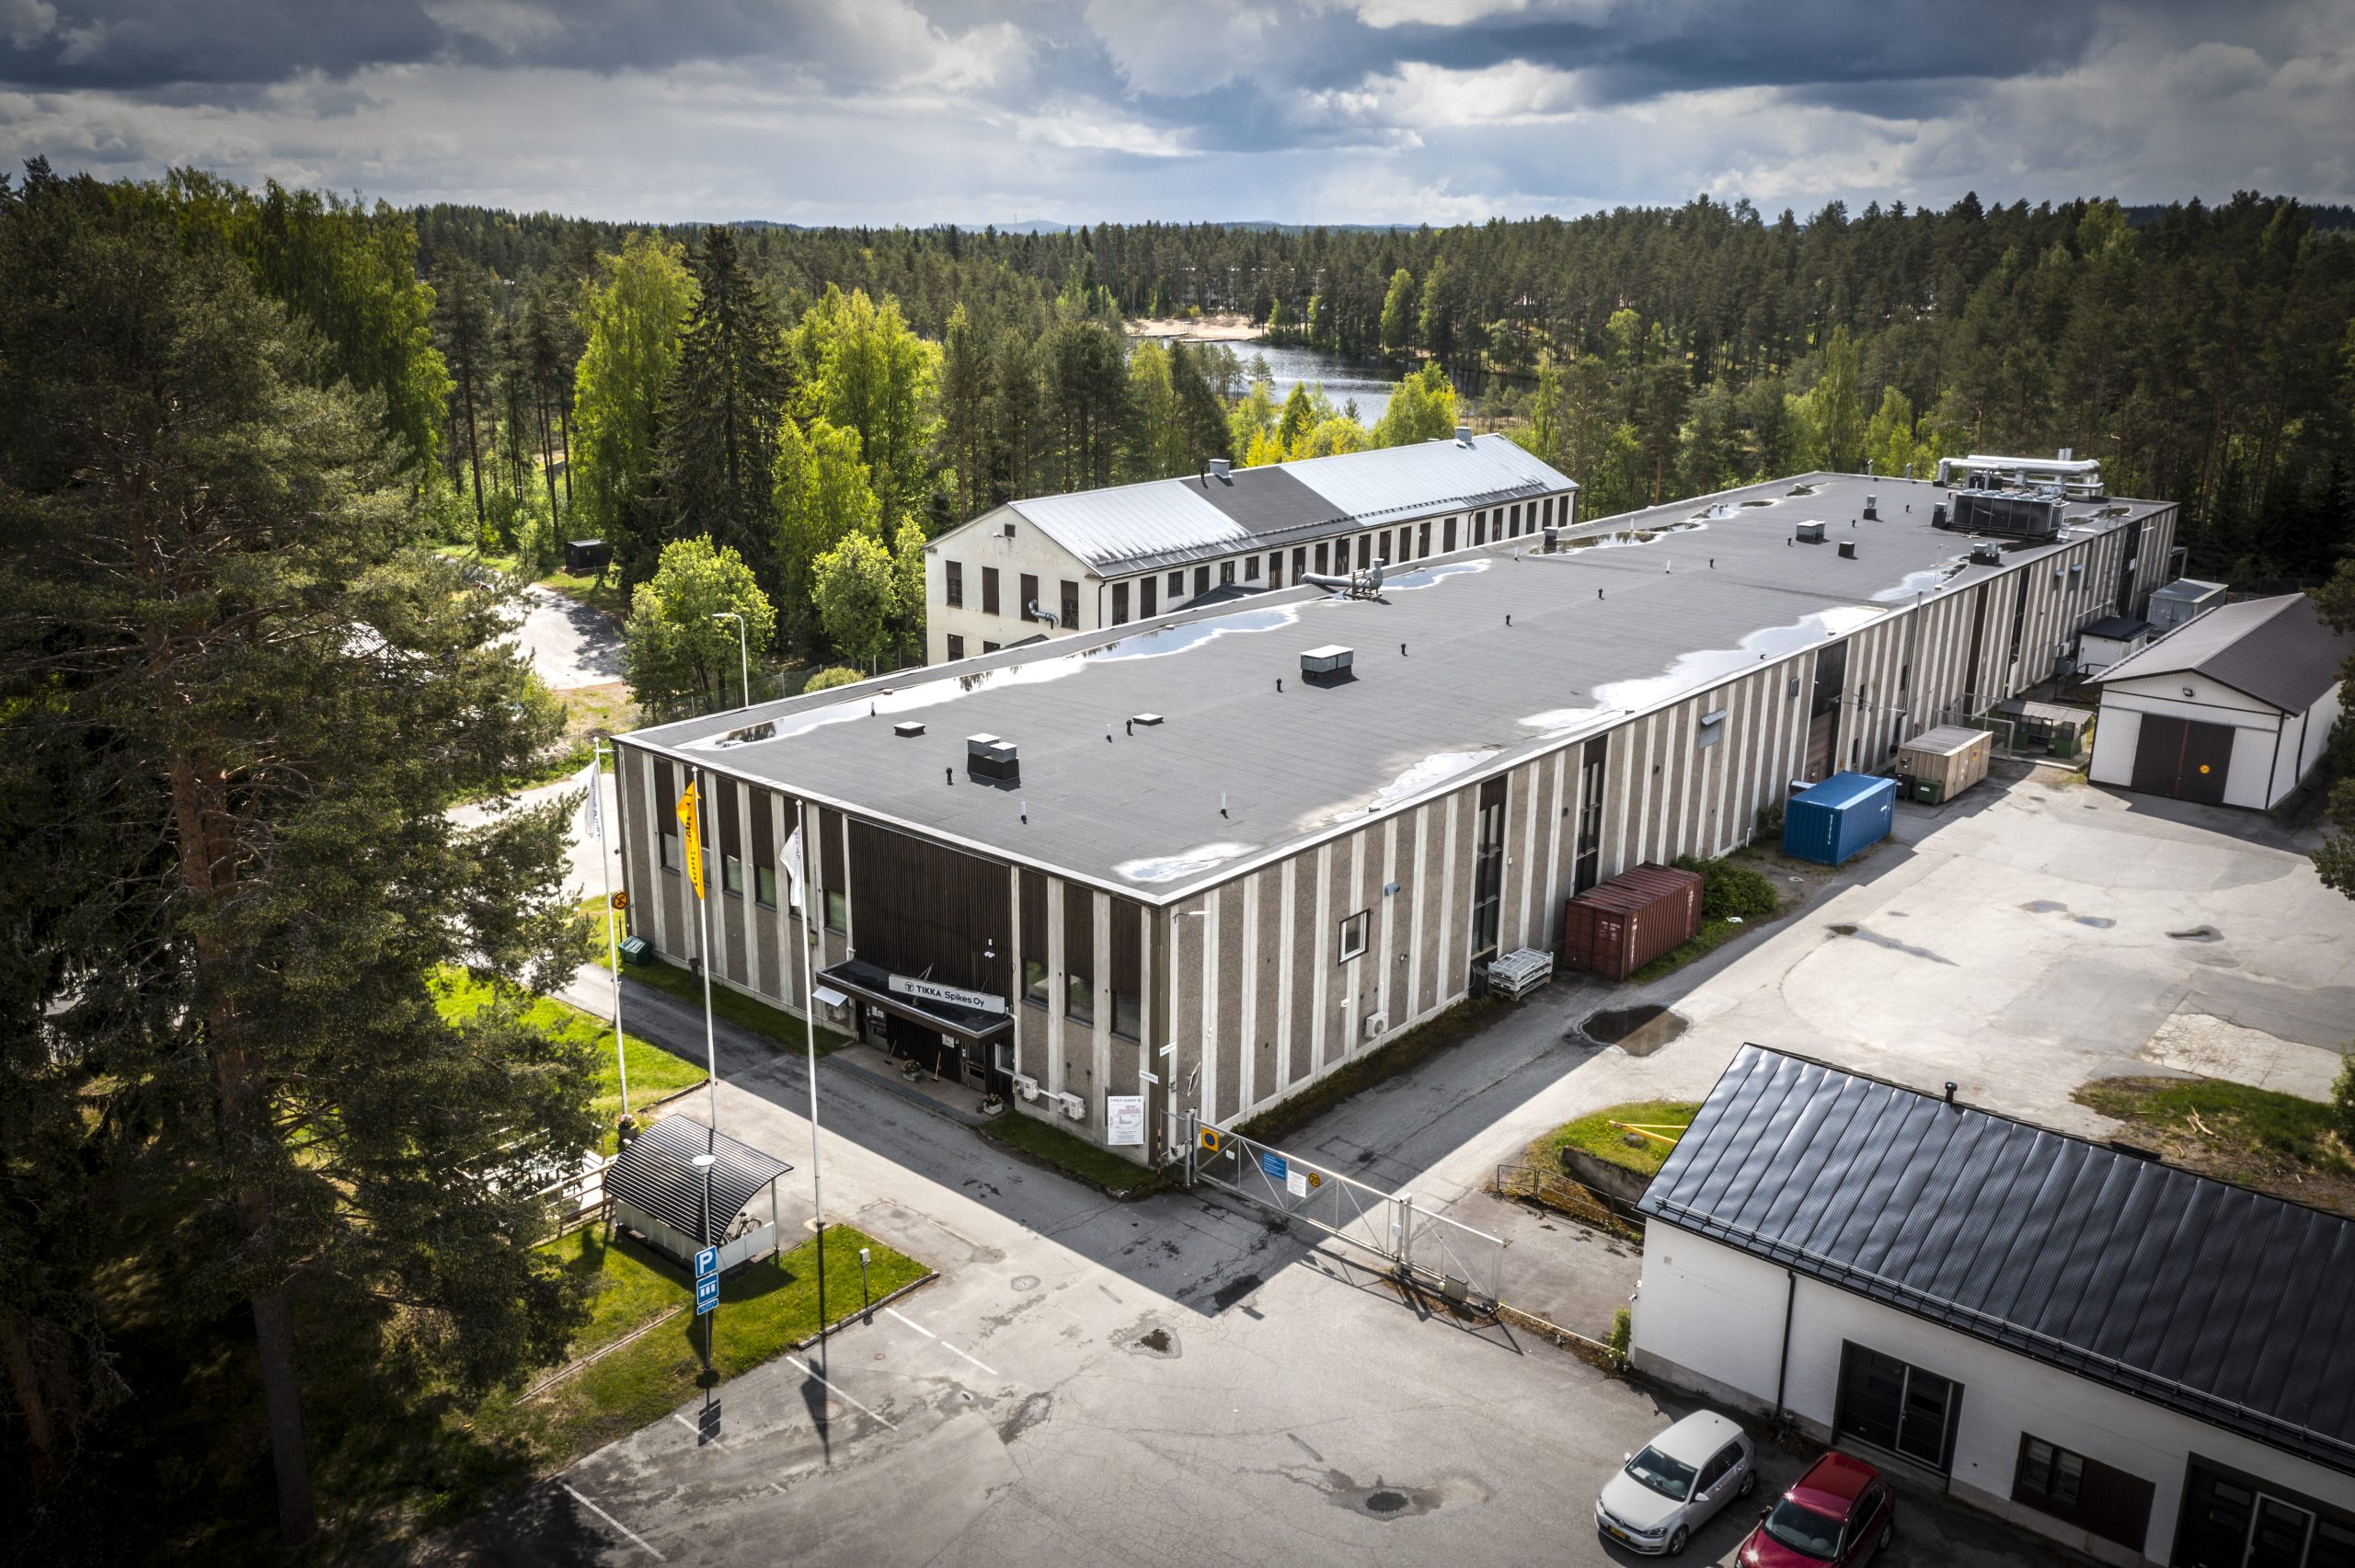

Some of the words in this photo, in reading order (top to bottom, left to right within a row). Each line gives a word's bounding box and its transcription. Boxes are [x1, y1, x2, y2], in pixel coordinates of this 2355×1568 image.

[916, 985, 942, 997] TIKKA
[944, 991, 972, 1003] Spikes
[973, 997, 984, 1007] Oy
[1311, 1175, 1319, 1185] 20
[699, 1251, 713, 1275] P
